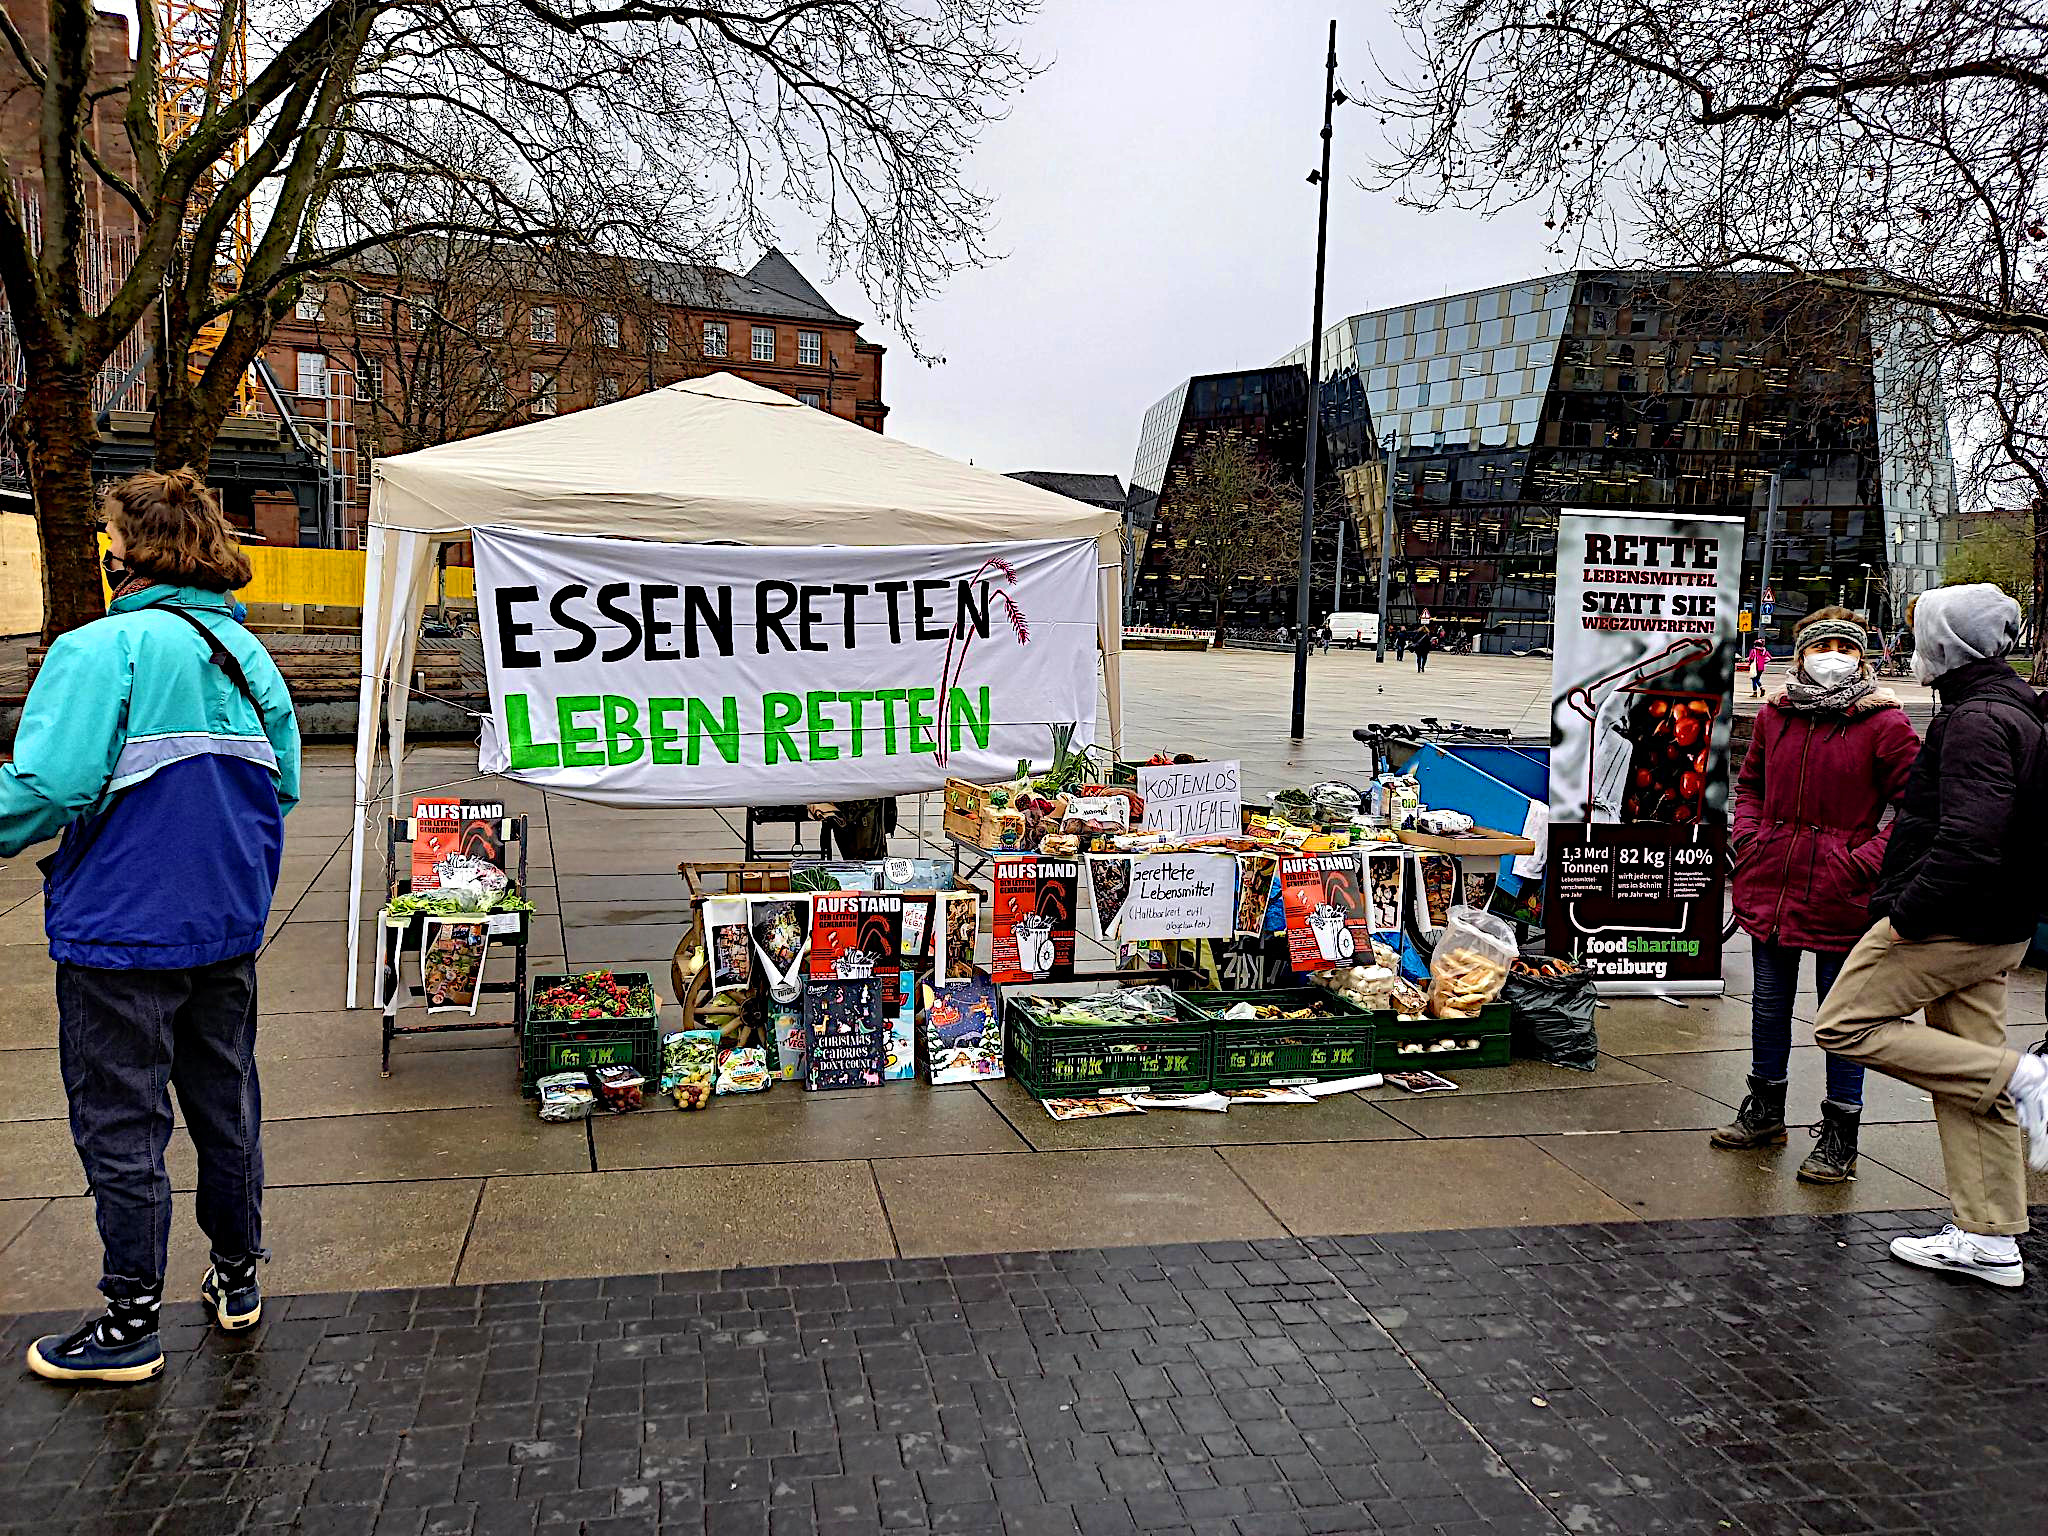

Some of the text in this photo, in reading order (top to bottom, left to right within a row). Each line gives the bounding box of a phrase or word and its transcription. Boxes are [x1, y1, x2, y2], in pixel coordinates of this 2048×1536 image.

[1583, 533, 1719, 569] RETTE
[1582, 568, 1718, 587] LEBENSMITTEL
[1582, 590, 1716, 616] STATT SIE
[494, 579, 991, 668] ESSEN RETTEN
[1581, 616, 1715, 633] WEGZUWERFEN!
[505, 685, 991, 769] LEBEN RETTEN
[1144, 769, 1238, 803] KOSTENLOS
[416, 804, 503, 820] AUFSTAND
[1562, 846, 1609, 861] 1,3 Mrd
[1619, 847, 1666, 868] 82 kg
[1674, 848, 1713, 865] 40%
[997, 863, 1077, 879] AUFSTAND
[1132, 862, 1195, 882] Gerettete
[1282, 856, 1354, 874] AUFSTAND
[1561, 861, 1609, 874] Tonnen
[1617, 872, 1633, 880] wirft
[1633, 872, 1651, 881] jeder
[1140, 882, 1215, 900] Lebensmittel
[816, 897, 901, 913] AUFSTAND
[1586, 936, 1700, 957] foodsharing
[1585, 957, 1668, 979] Freiburg
